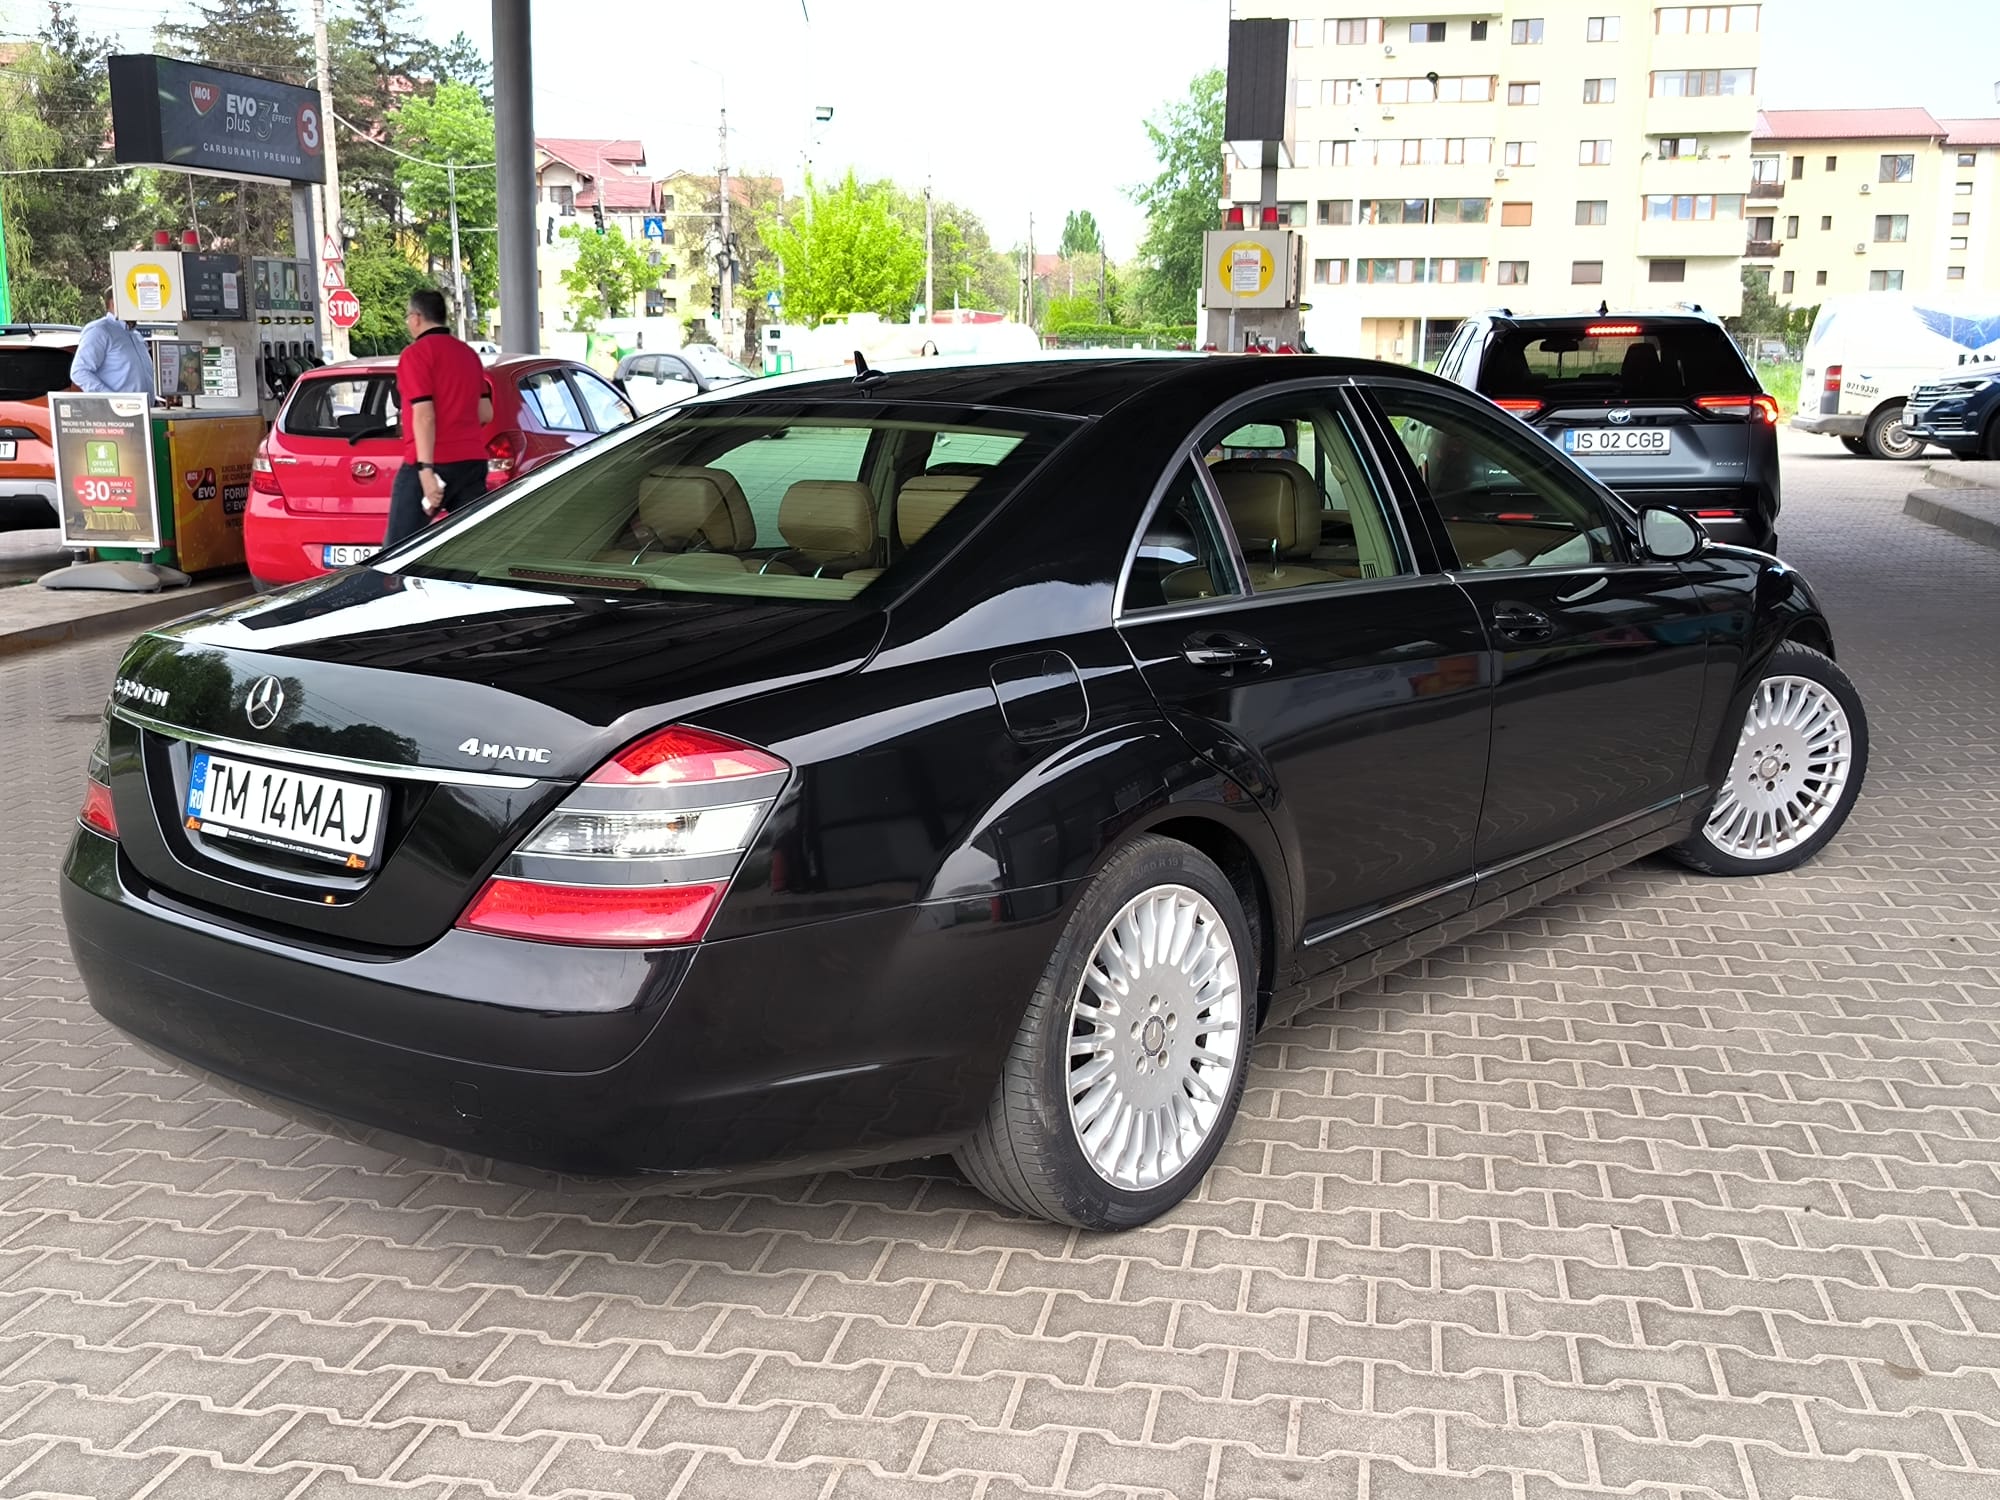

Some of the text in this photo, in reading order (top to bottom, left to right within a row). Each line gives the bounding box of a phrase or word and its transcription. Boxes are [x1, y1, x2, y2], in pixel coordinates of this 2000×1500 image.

[194, 86, 211, 101] MOL
[226, 93, 257, 117] EVO
[225, 114, 251, 133] plus
[271, 113, 292, 125] EFFECT
[301, 109, 318, 148] 3
[264, 151, 302, 165] PREMIUM
[328, 299, 359, 318] STOP
[1577, 433, 1593, 449] IS
[1600, 433, 1620, 449] 02
[1626, 432, 1664, 449] CGB
[78, 480, 110, 502] -30
[198, 486, 216, 499] EVO
[334, 548, 347, 563] IS
[353, 548, 371, 563] 08
[189, 788, 204, 810] RO
[210, 763, 251, 820] TM
